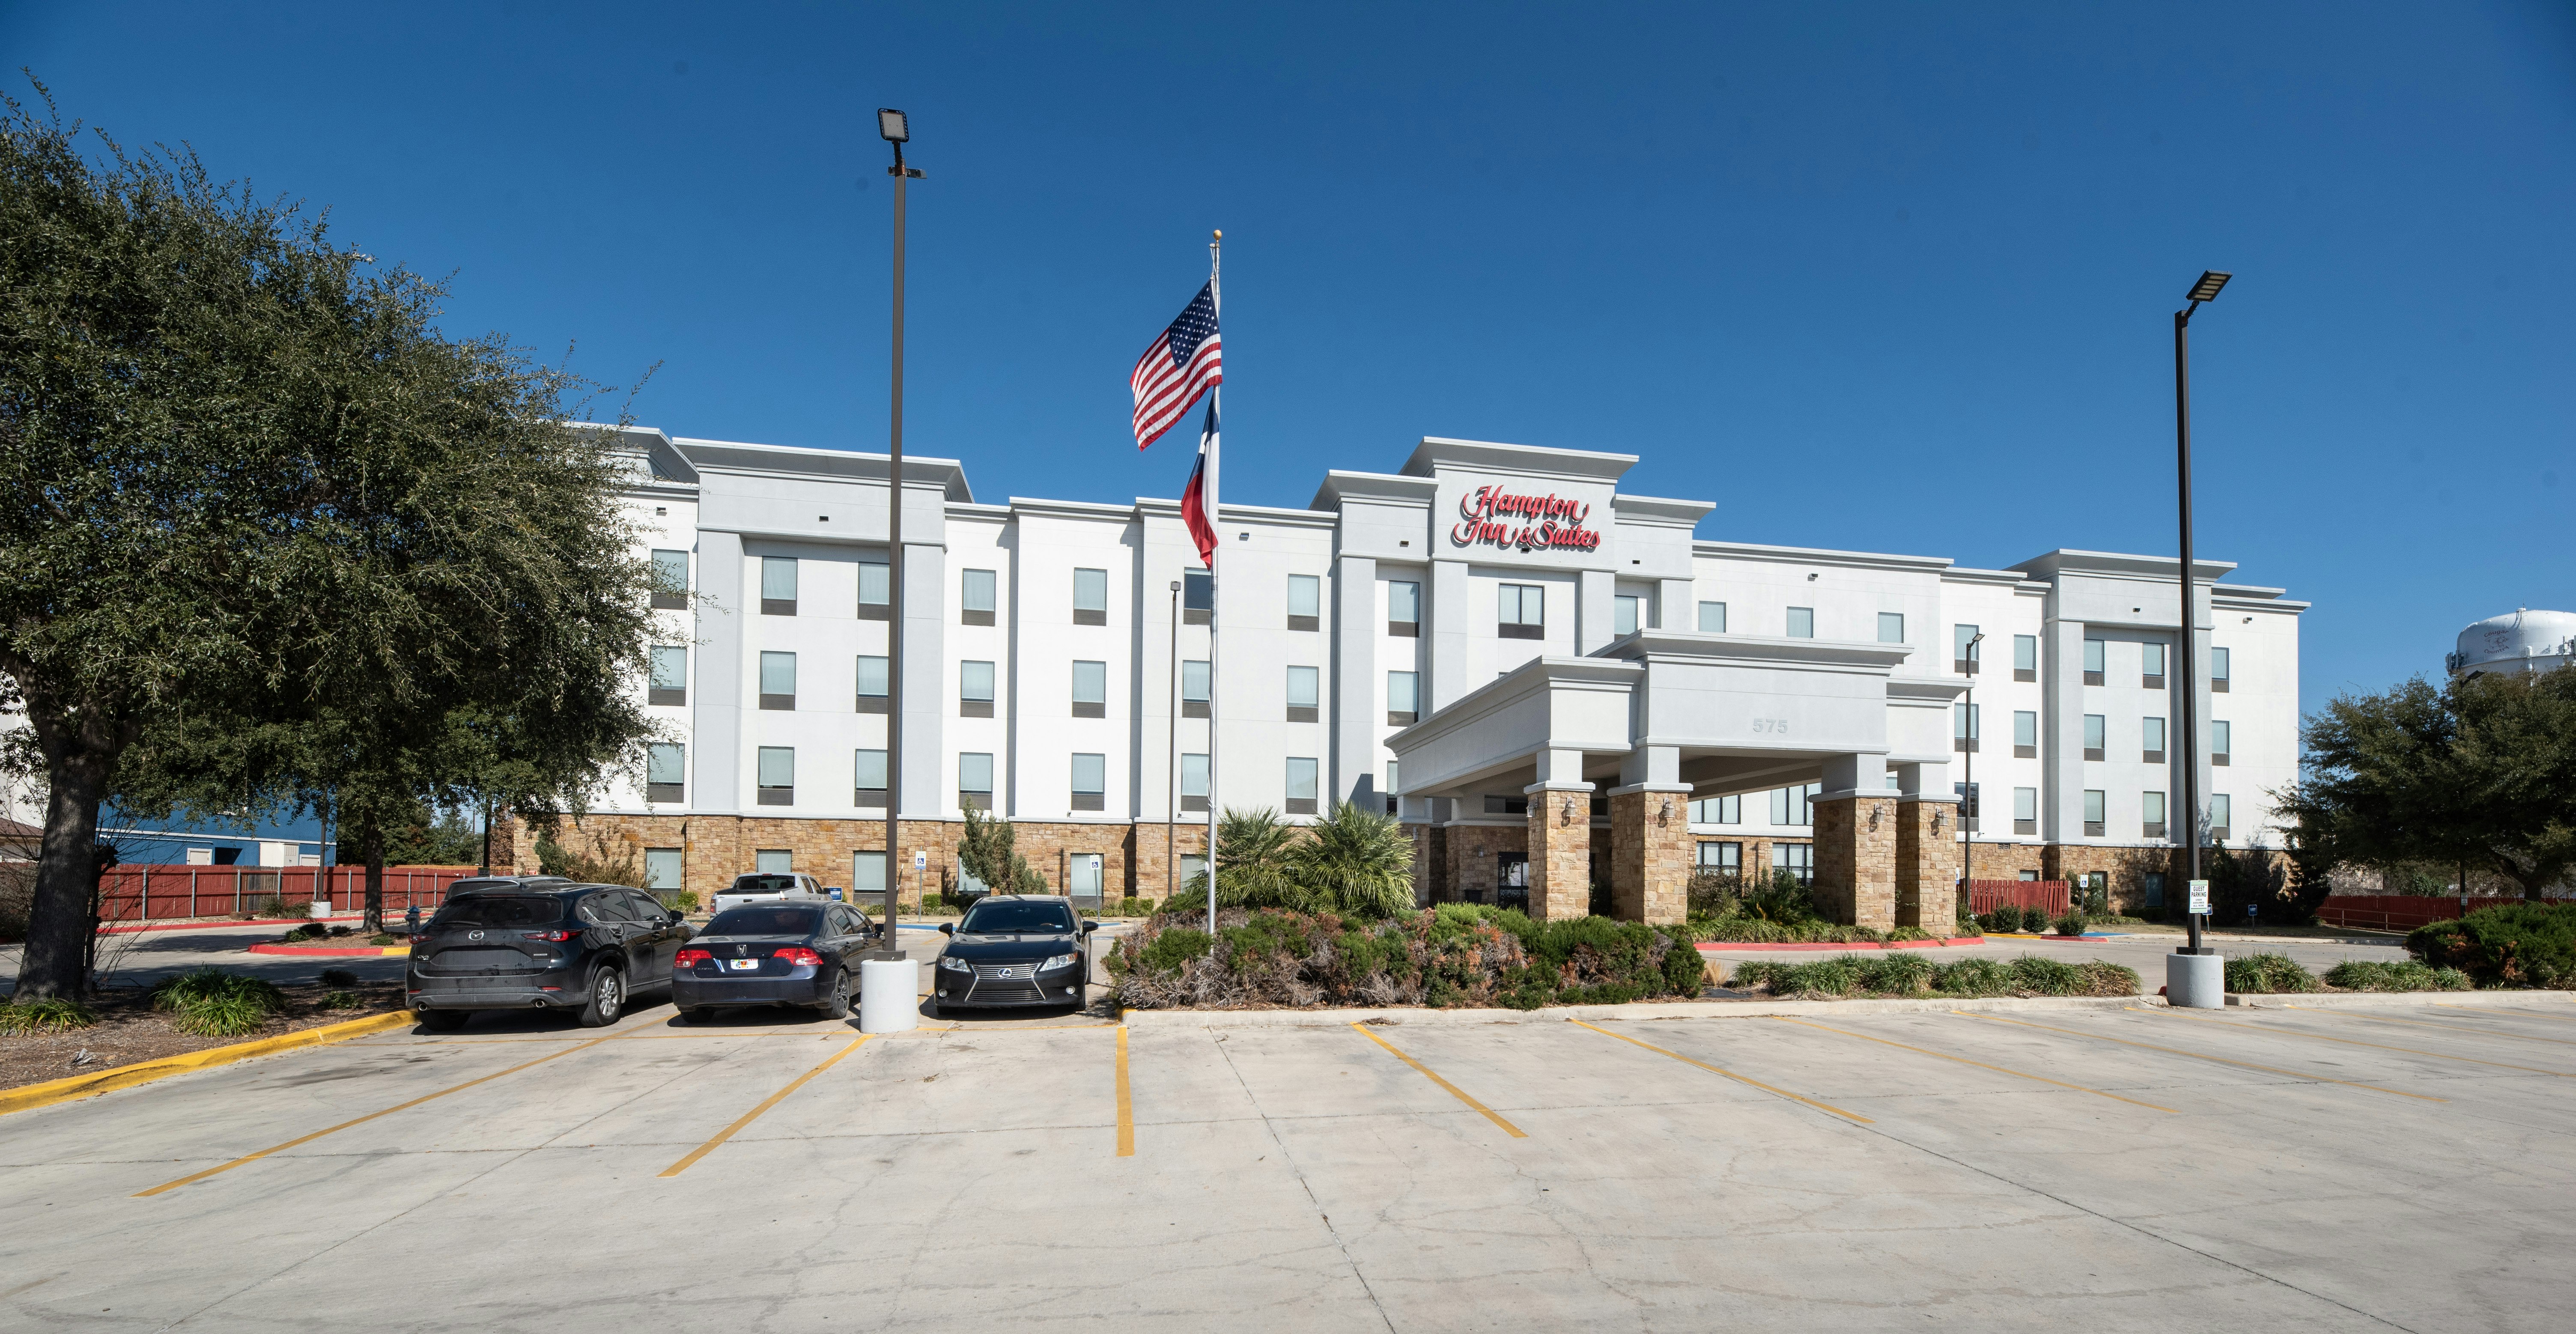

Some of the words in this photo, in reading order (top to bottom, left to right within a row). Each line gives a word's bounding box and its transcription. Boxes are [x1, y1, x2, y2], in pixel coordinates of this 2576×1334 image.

[1462, 485, 1589, 521] Hampton
[1454, 516, 1518, 545] Inn
[1520, 527, 1535, 546] &
[1534, 521, 1601, 548] Suites
[2484, 646, 2509, 654] Country
[1753, 719, 1788, 733] 575
